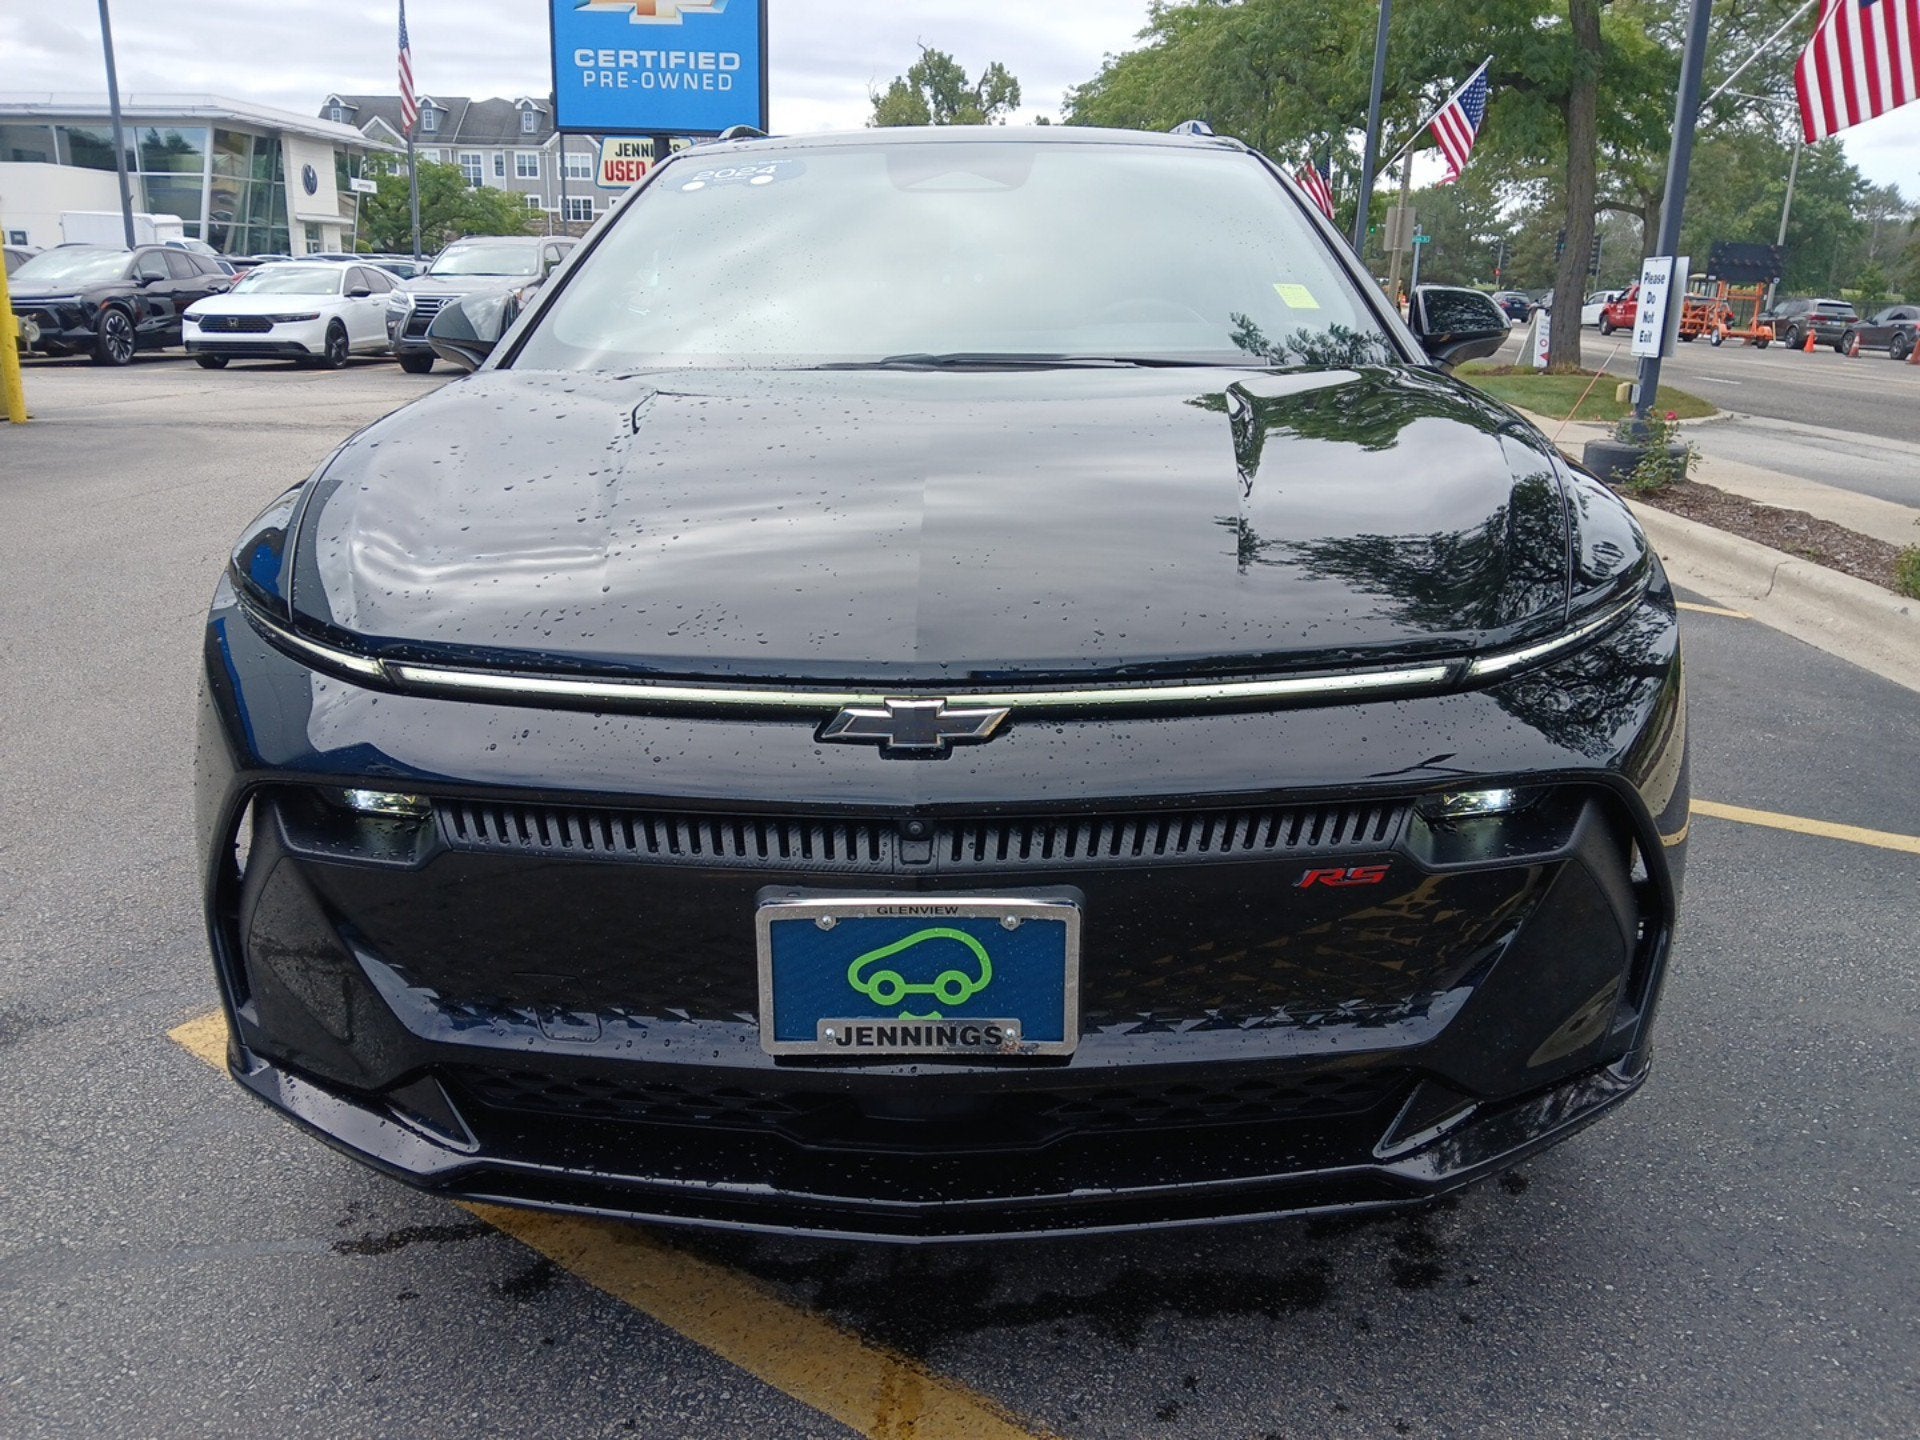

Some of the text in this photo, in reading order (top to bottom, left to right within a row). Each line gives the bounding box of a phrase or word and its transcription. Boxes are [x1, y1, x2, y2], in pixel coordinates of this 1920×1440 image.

[574, 48, 741, 71] CERTIFIED
[583, 71, 733, 91] PRE-OWNED
[615, 142, 681, 157] JENNIS
[604, 160, 646, 182] USED
[692, 165, 777, 181] 2024
[1644, 271, 1666, 285] Please
[1646, 291, 1656, 304] Do
[1643, 310, 1655, 324] Not
[1299, 864, 1392, 888] RS
[876, 906, 959, 916] GLENVIEW
[835, 1026, 1003, 1047] JENNINGS
